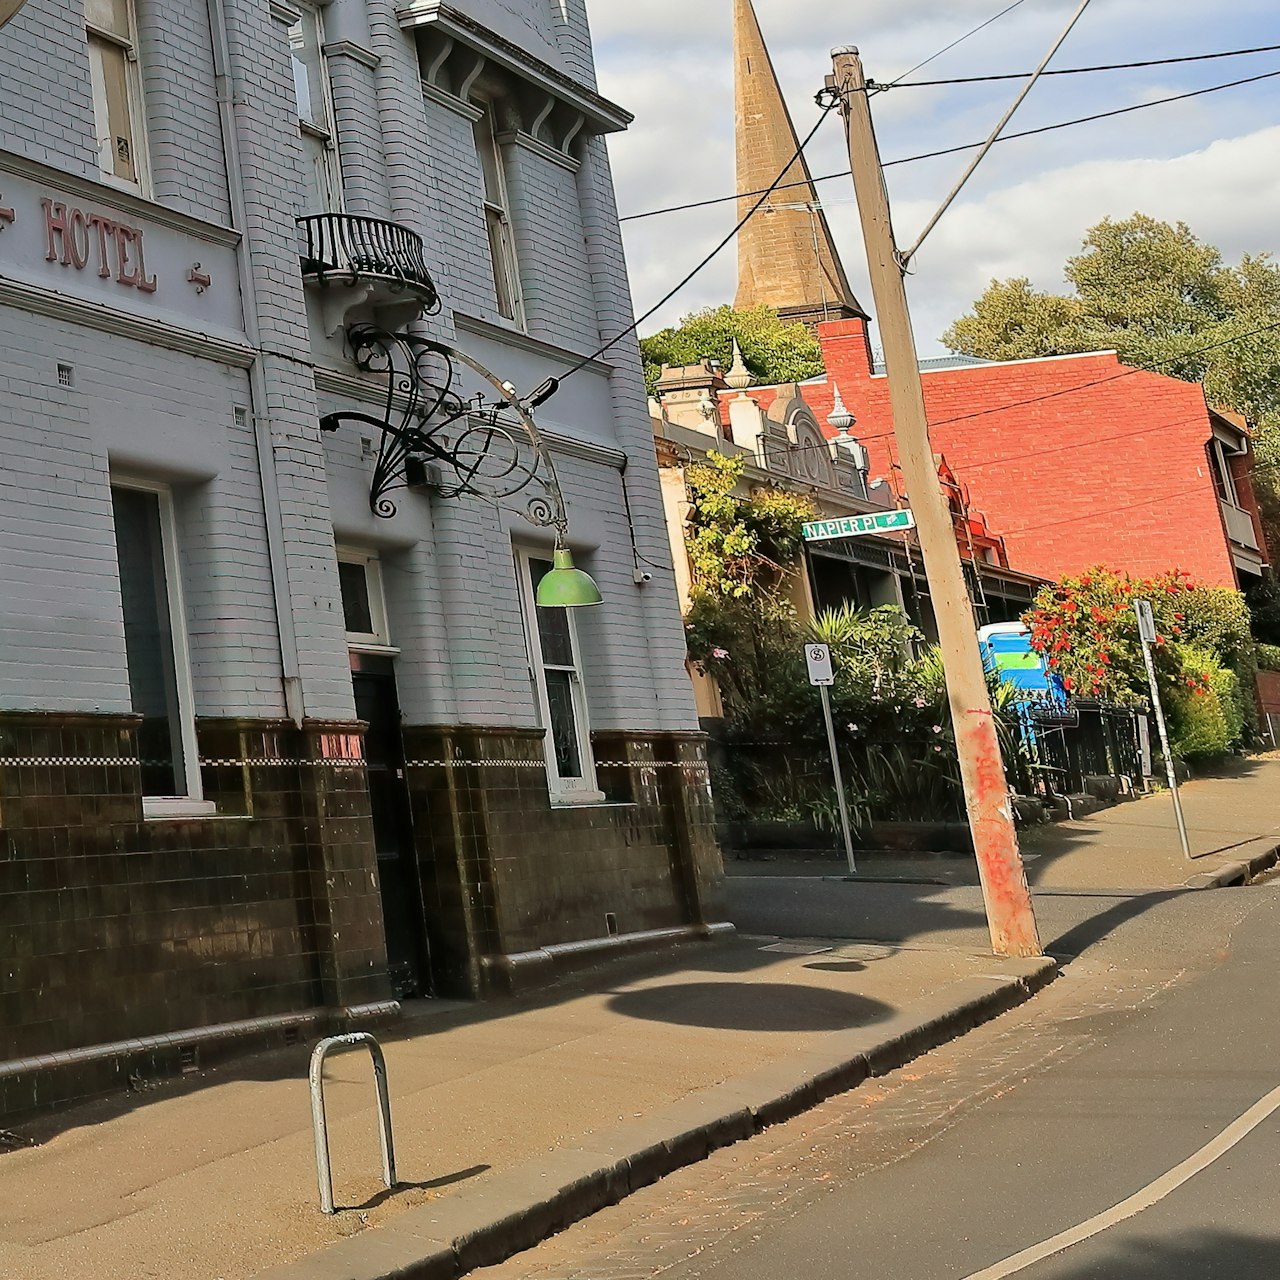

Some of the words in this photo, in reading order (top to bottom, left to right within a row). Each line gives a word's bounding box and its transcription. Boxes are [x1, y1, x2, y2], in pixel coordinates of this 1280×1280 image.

[41, 196, 157, 293] HOTEL
[807, 519, 859, 538] NAPIER
[863, 517, 882, 531] PL
